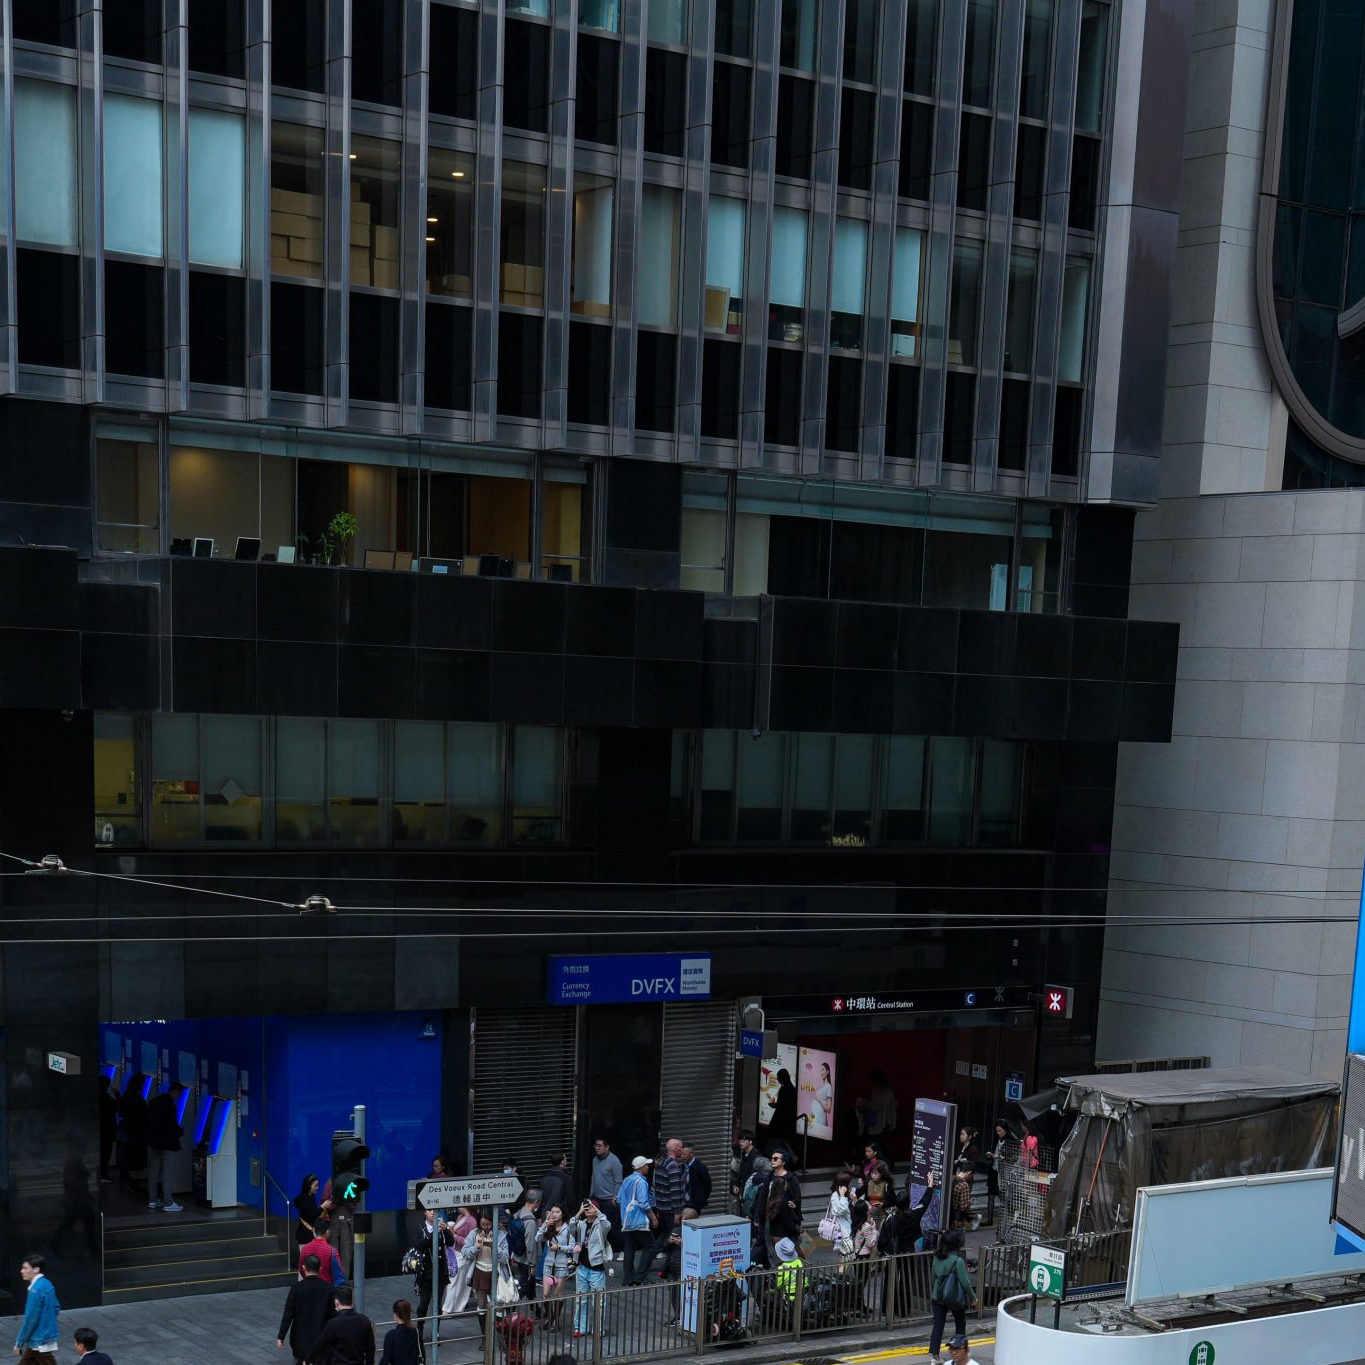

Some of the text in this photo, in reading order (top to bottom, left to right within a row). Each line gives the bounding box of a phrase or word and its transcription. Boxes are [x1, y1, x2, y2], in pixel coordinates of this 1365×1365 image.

[562, 982, 590, 991] Currency
[631, 978, 675, 995] DVFX
[562, 991, 591, 999] Exchange
[966, 994, 974, 1004] C
[846, 997, 914, 1011] 中環站 Central Station
[443, 1184, 465, 1192] Voeux
[488, 1181, 514, 1189] Central
